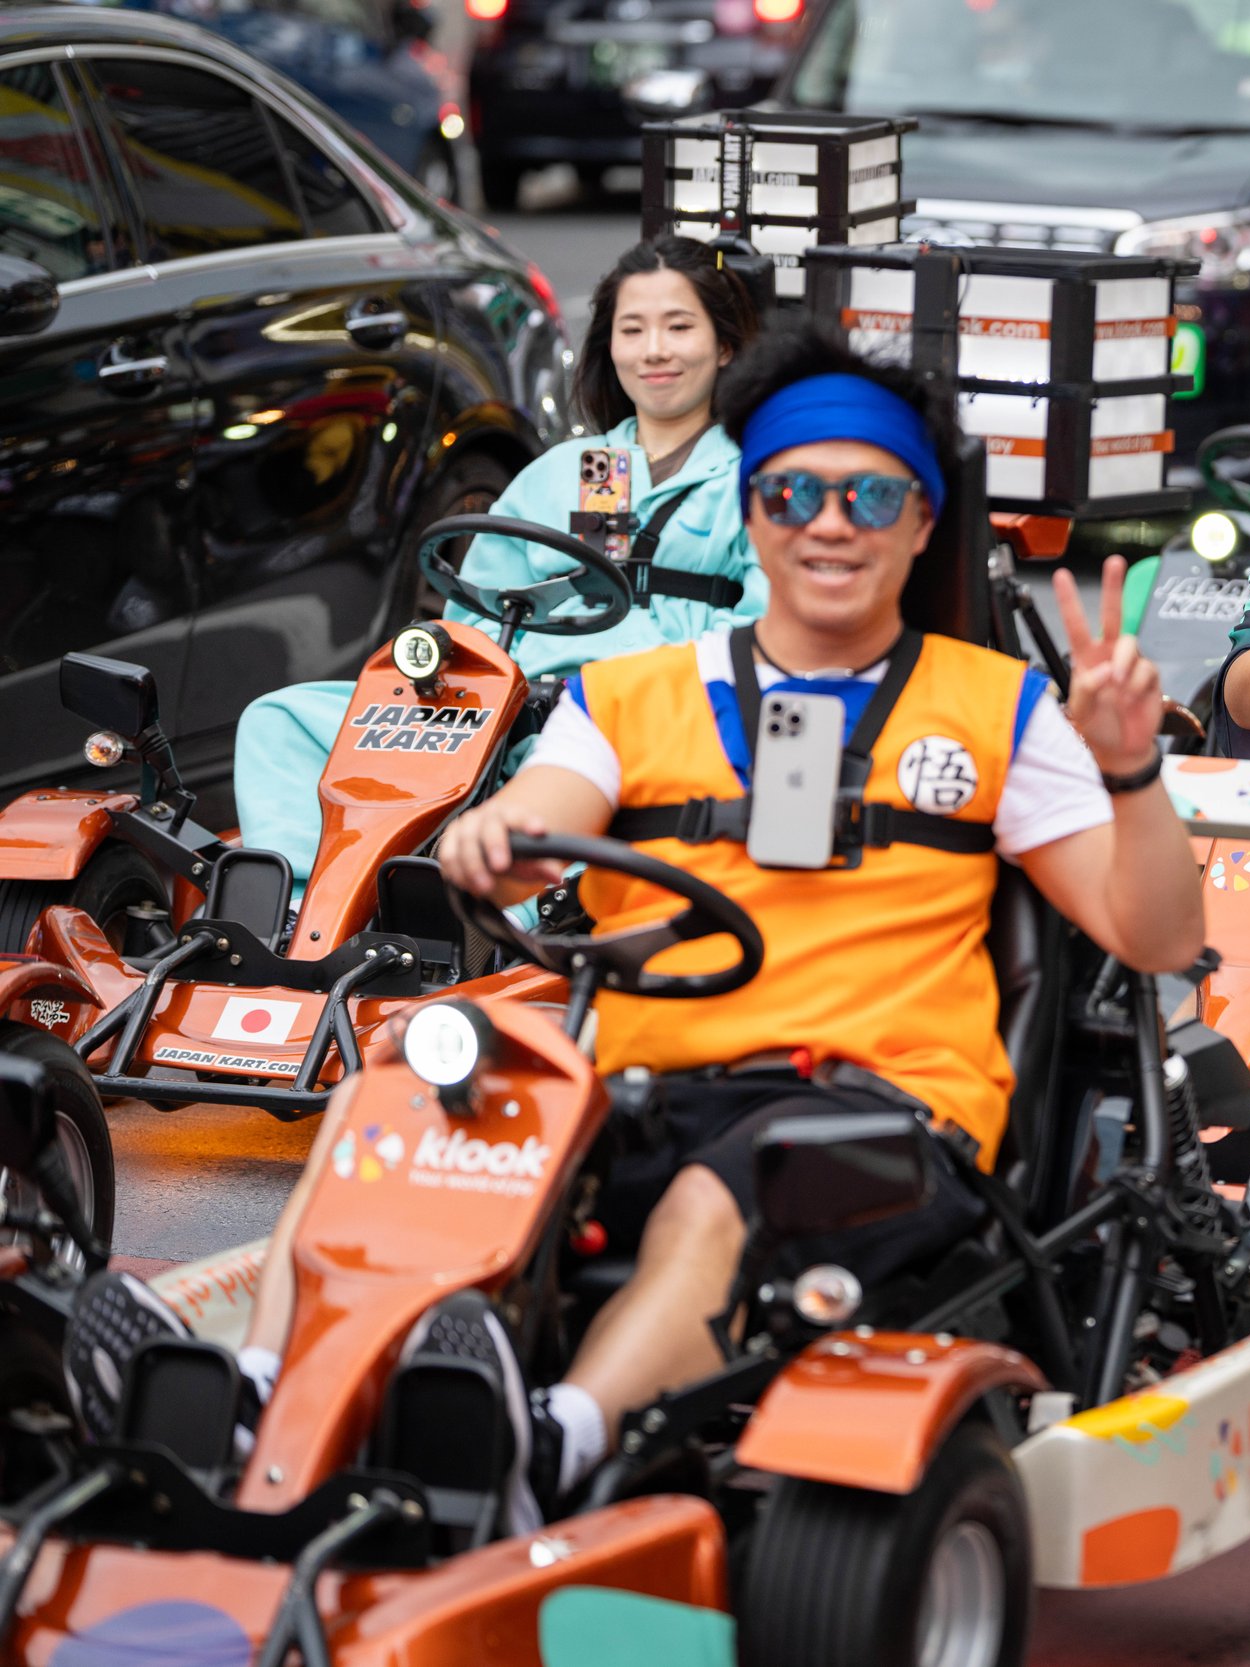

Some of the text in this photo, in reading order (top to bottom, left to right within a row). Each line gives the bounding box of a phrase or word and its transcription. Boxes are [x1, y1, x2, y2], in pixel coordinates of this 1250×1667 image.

[1153, 576, 1249, 599] JAPA
[1158, 596, 1246, 621] KAR
[351, 704, 494, 730] JAPAN
[354, 728, 475, 753] KART
[905, 740, 977, 810] 悟
[155, 1048, 216, 1064] JAPAN
[412, 1126, 550, 1178] klook
